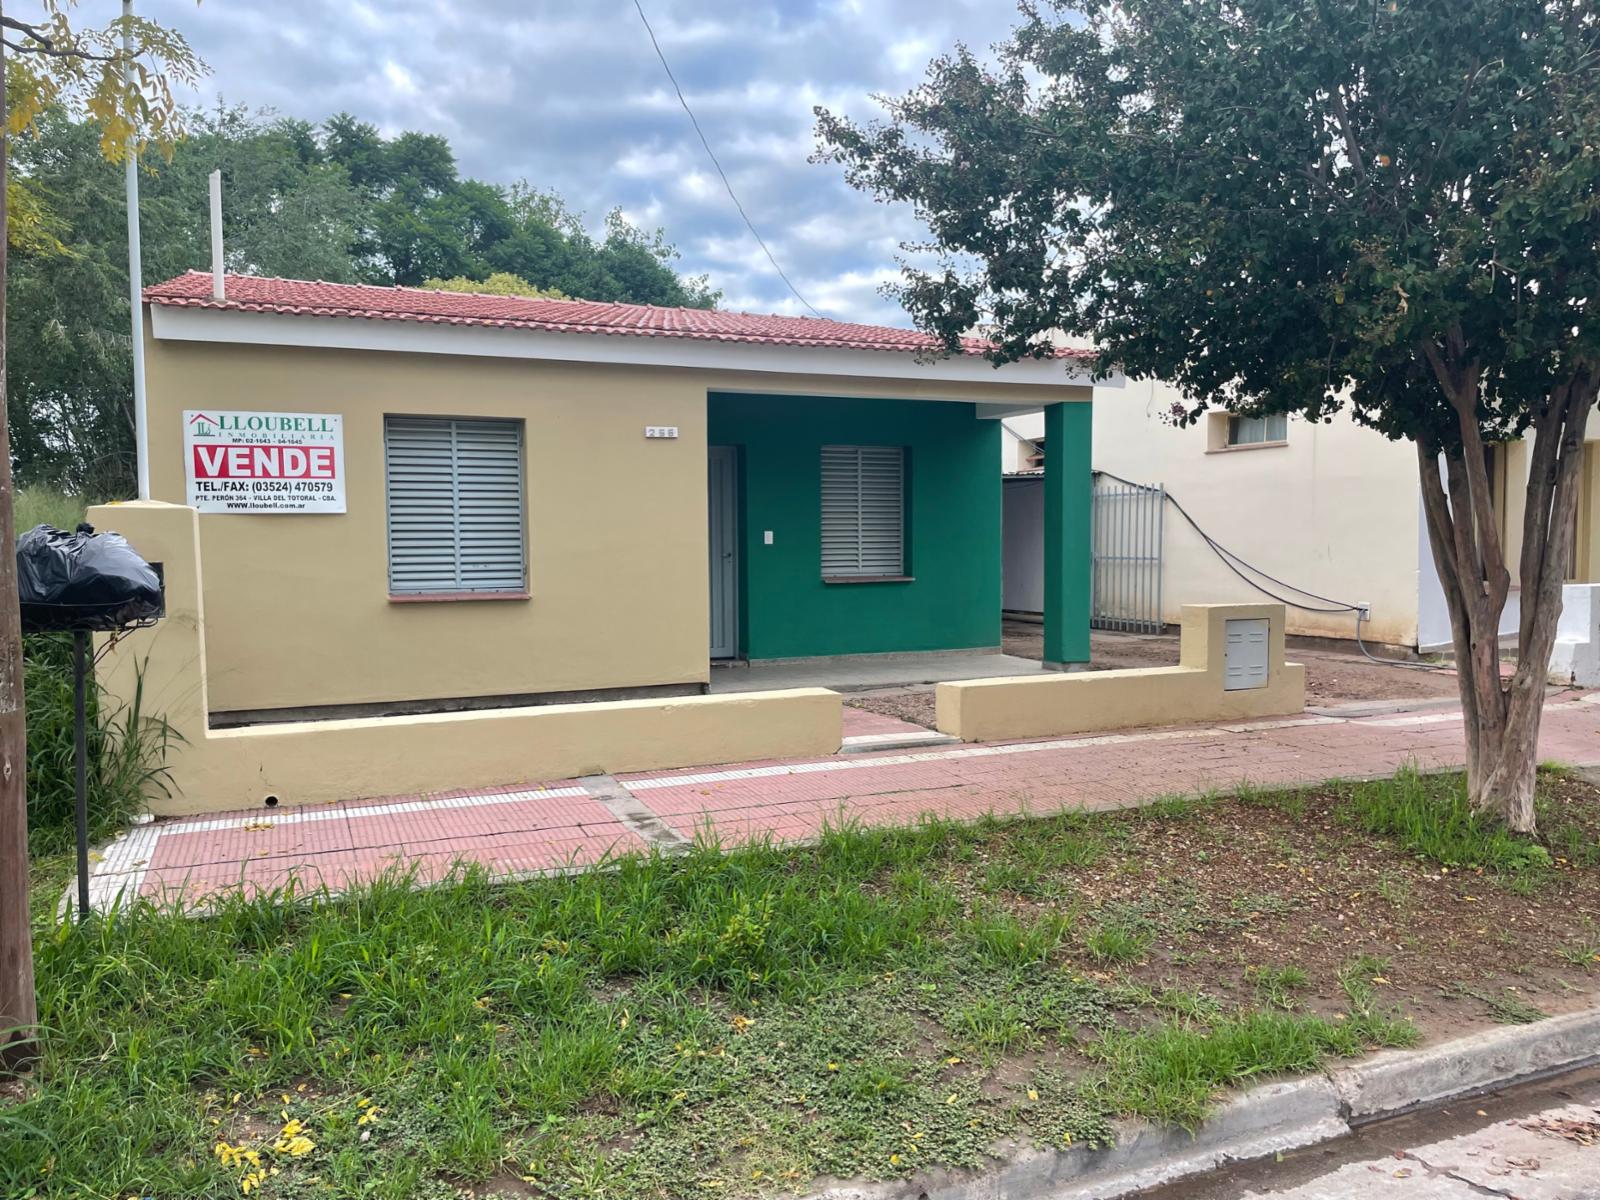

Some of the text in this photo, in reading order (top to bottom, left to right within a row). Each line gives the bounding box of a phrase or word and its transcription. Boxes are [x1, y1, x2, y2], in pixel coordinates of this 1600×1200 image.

[218, 416, 334, 432] LLOUBELL
[218, 432, 334, 440] INMOBILIARIA
[197, 447, 332, 477] VENDE
[195, 481, 333, 494] TEL./FAX: (03524) 470579
